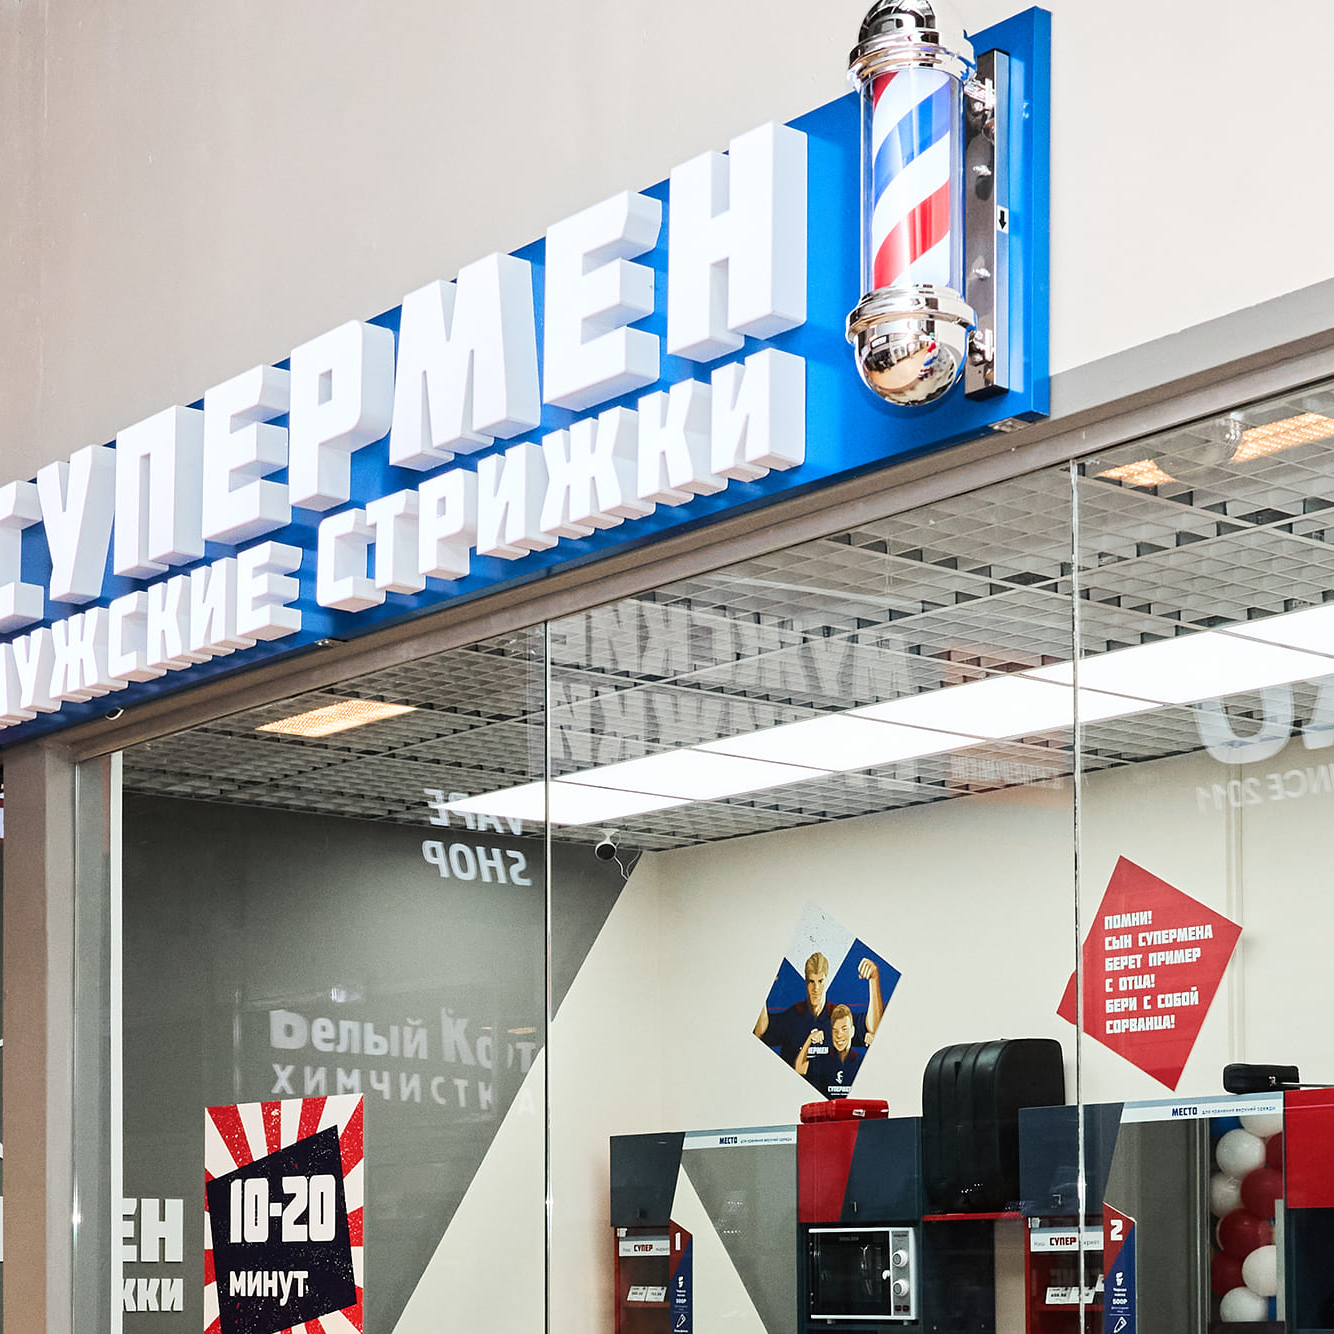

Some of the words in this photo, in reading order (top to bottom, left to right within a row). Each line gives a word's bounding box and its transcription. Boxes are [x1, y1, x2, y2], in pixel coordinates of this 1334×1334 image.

[317, 347, 806, 611] СТРИЖКИ
[1104, 910, 1152, 930] ПОМНИ!
[1105, 934, 1132, 951] СЫН
[1138, 924, 1213, 947] СУПЕРМЕНА
[1105, 954, 1143, 972] БЕРЕТ
[1148, 947, 1201, 967] ПРИМЕР
[1105, 978, 1113, 993] С
[1119, 974, 1155, 991] ОТЦА!
[1105, 996, 1137, 1014] БЕРИ
[1143, 995, 1152, 1010] С
[1157, 986, 1199, 1009] СОБОЙ
[1105, 1014, 1176, 1034] СОРВАНЦА!
[1171, 1107, 1198, 1117] МЕСТО
[230, 1174, 336, 1243] 10-20
[1049, 1237, 1077, 1246] СУПЕР
[1110, 1219, 1123, 1241] 2
[230, 1271, 308, 1306] минут
